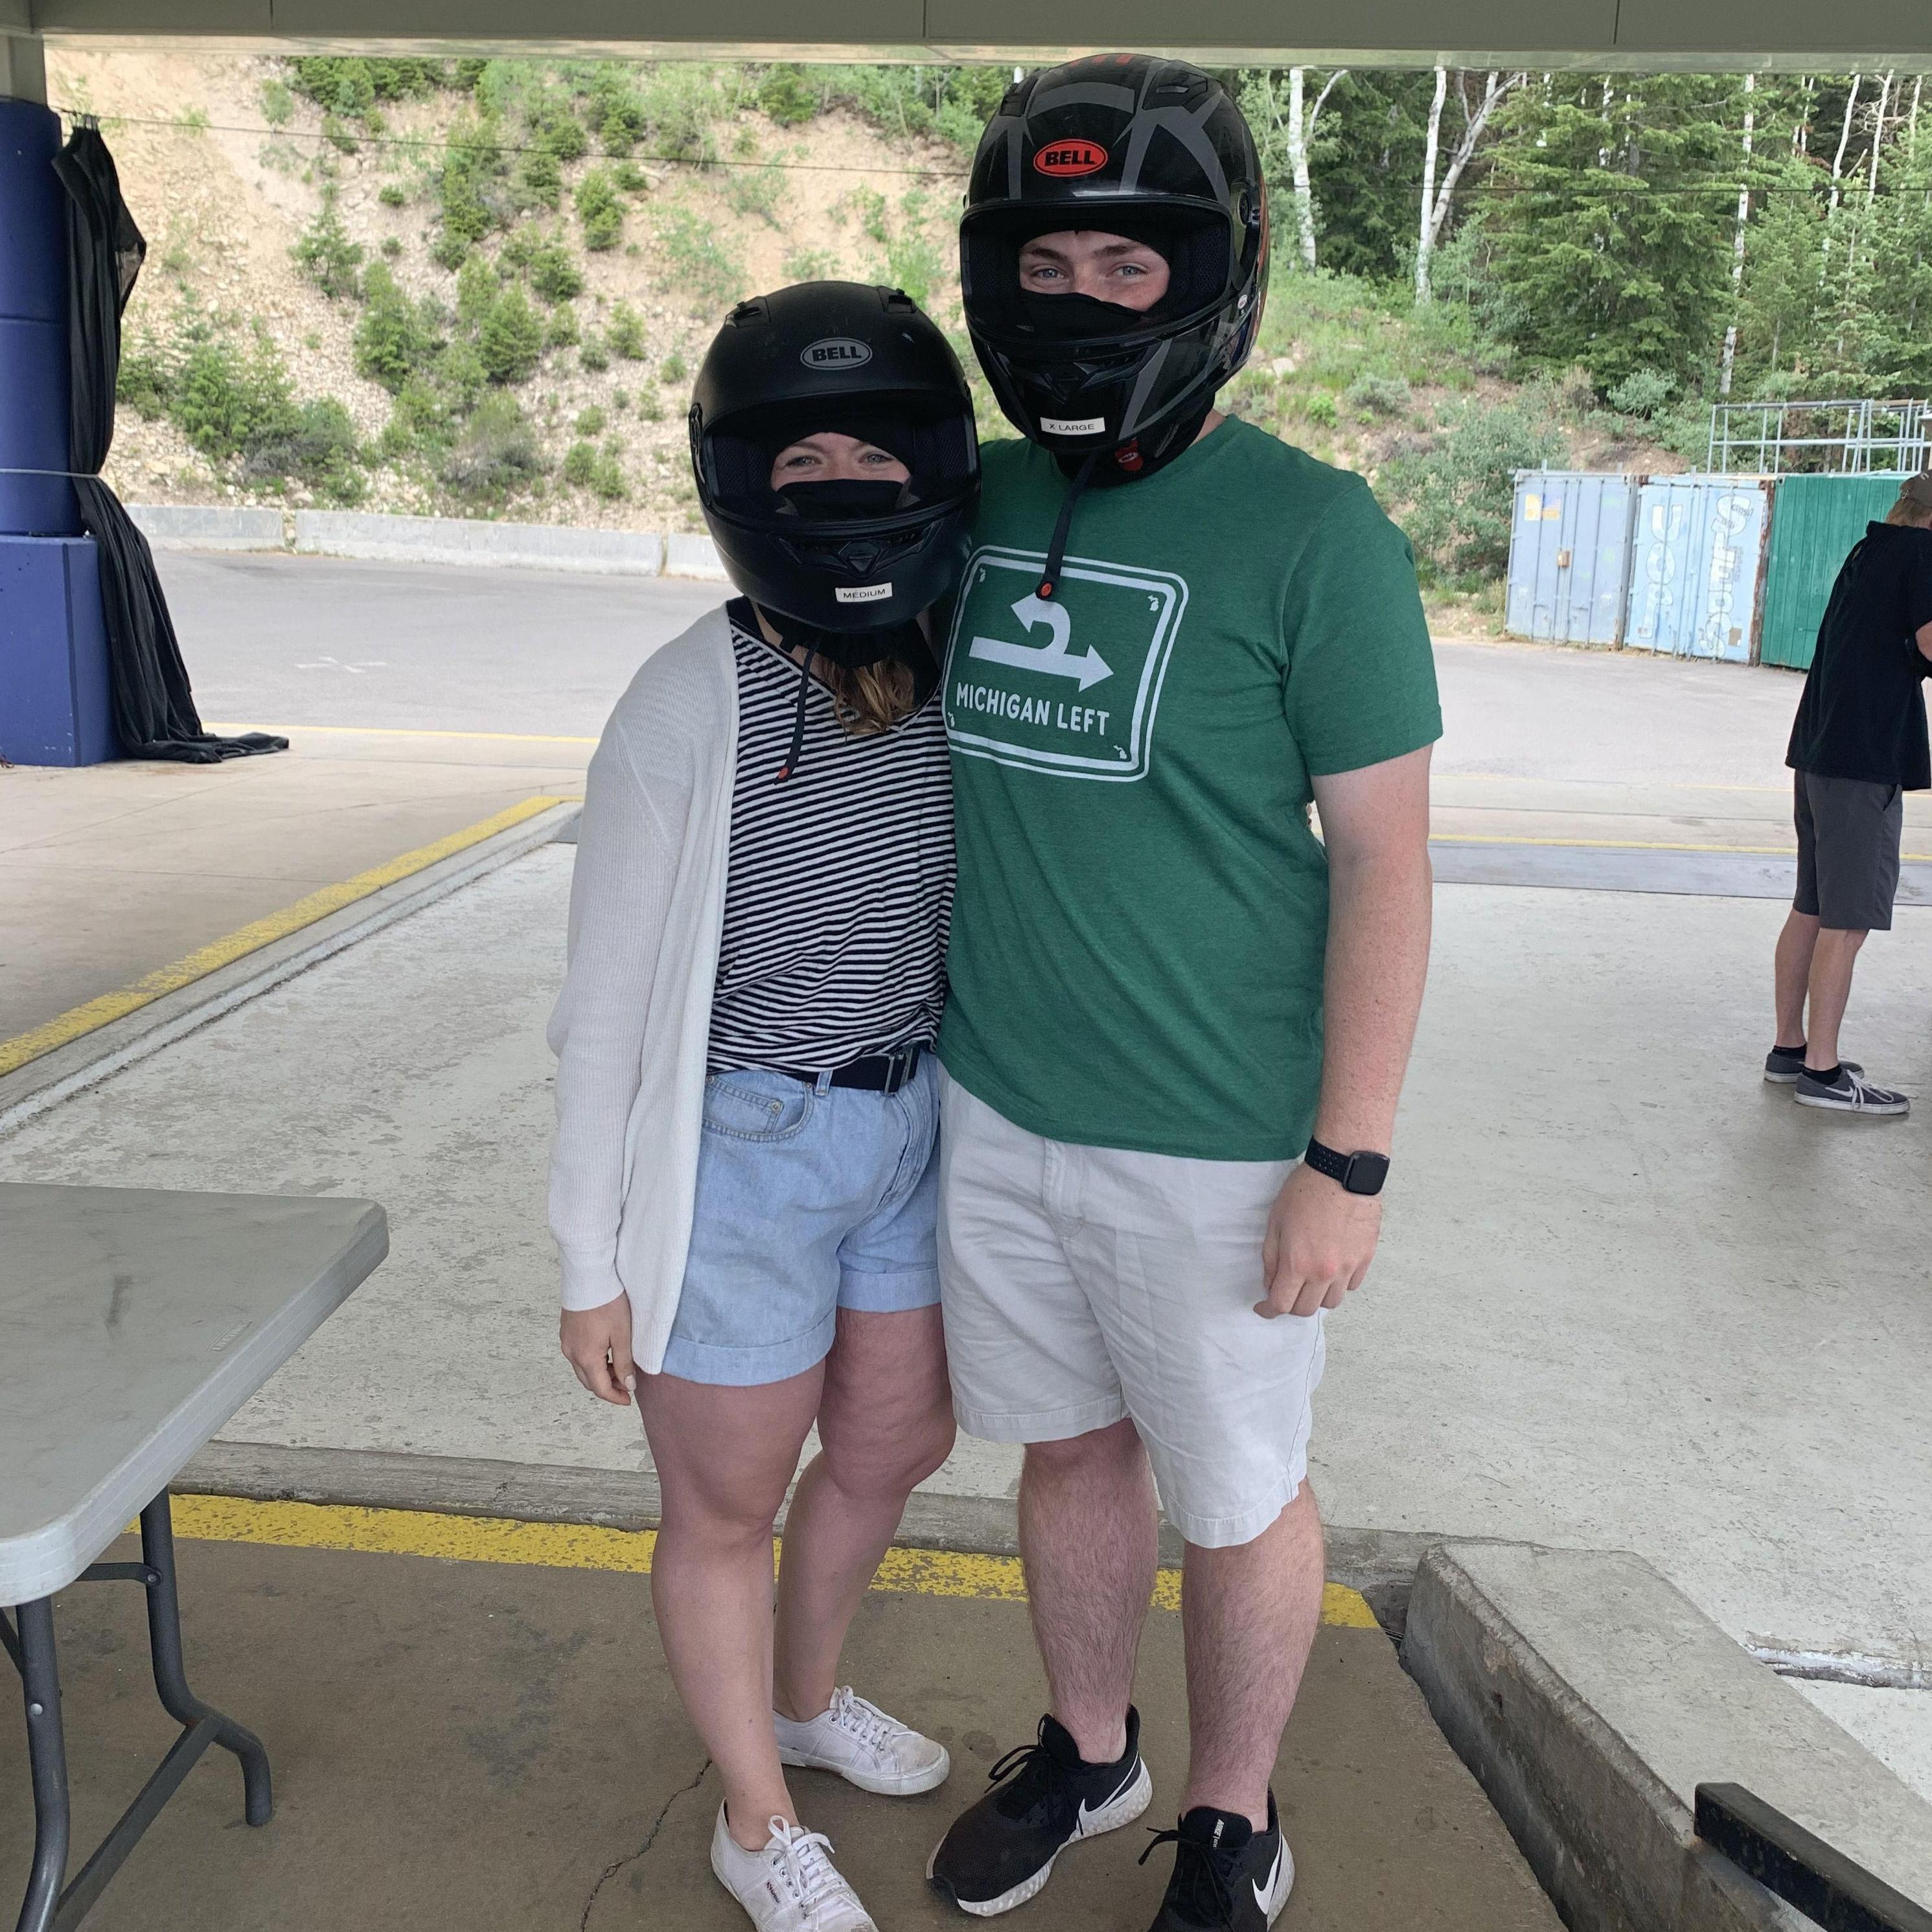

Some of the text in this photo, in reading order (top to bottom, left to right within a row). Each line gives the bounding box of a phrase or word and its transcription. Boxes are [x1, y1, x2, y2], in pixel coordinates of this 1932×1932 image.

[1044, 150, 1097, 167] BELL
[812, 346, 862, 362] BELL
[844, 588, 886, 599] MEDIUM
[956, 682, 1110, 736] MICHIGAN LEFT
